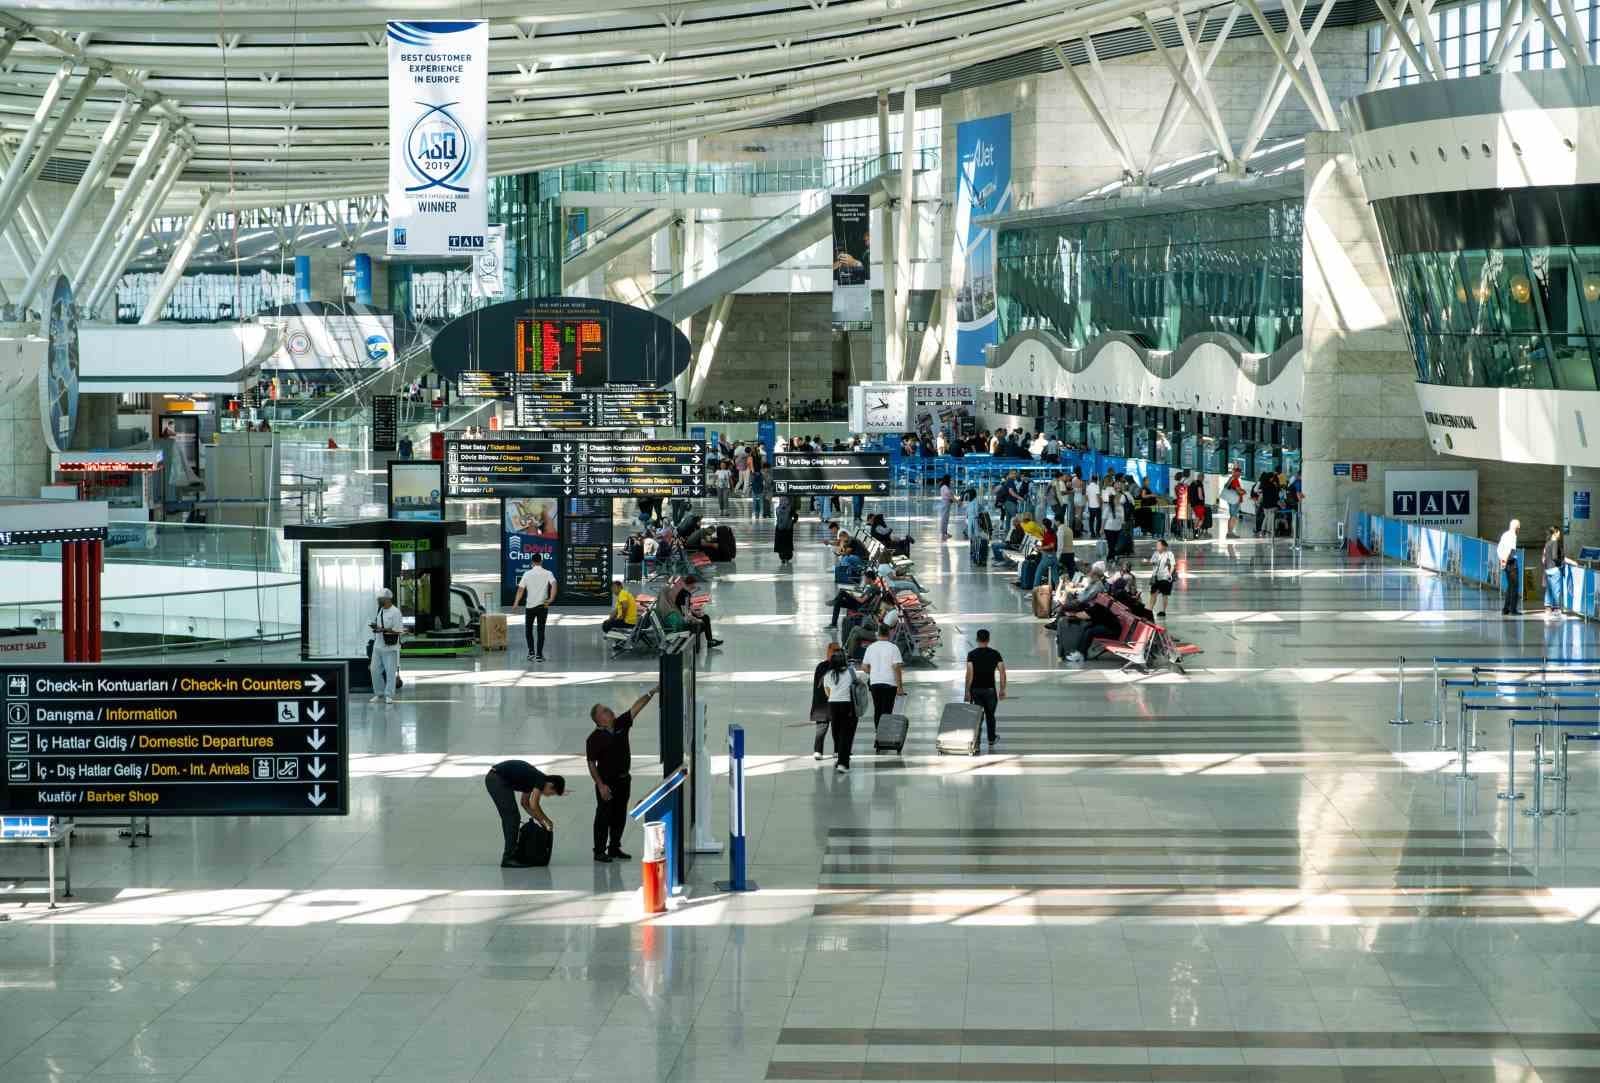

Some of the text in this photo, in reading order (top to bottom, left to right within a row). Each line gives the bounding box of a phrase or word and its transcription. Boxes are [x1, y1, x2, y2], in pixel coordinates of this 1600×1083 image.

[401, 54, 472, 62] BEST CUSTOMER
[409, 64, 464, 73] EXPERIENCE
[414, 75, 460, 84] IN EUROPE
[418, 132, 457, 160] ASQ
[424, 162, 451, 171] 2019
[418, 201, 457, 213] WINNER
[449, 236, 484, 247] TAV
[1394, 491, 1467, 513] TAV
[36, 677, 302, 692] Check-in Kontuarları / Check-in Counters
[36, 707, 178, 723] Danışma / Information
[37, 734, 274, 751] İç Hatlar Gidiş / Domestic Departures
[37, 763, 48, 779] İç
[57, 764, 76, 779] Dış
[78, 764, 111, 777] Hatlar
[114, 763, 142, 779] Geliş
[144, 763, 149, 777] /
[152, 763, 180, 777] Dom.
[190, 763, 207, 777] Int.
[209, 763, 250, 777] Arrivals
[38, 790, 159, 805] Kuaför / Barber Shop
